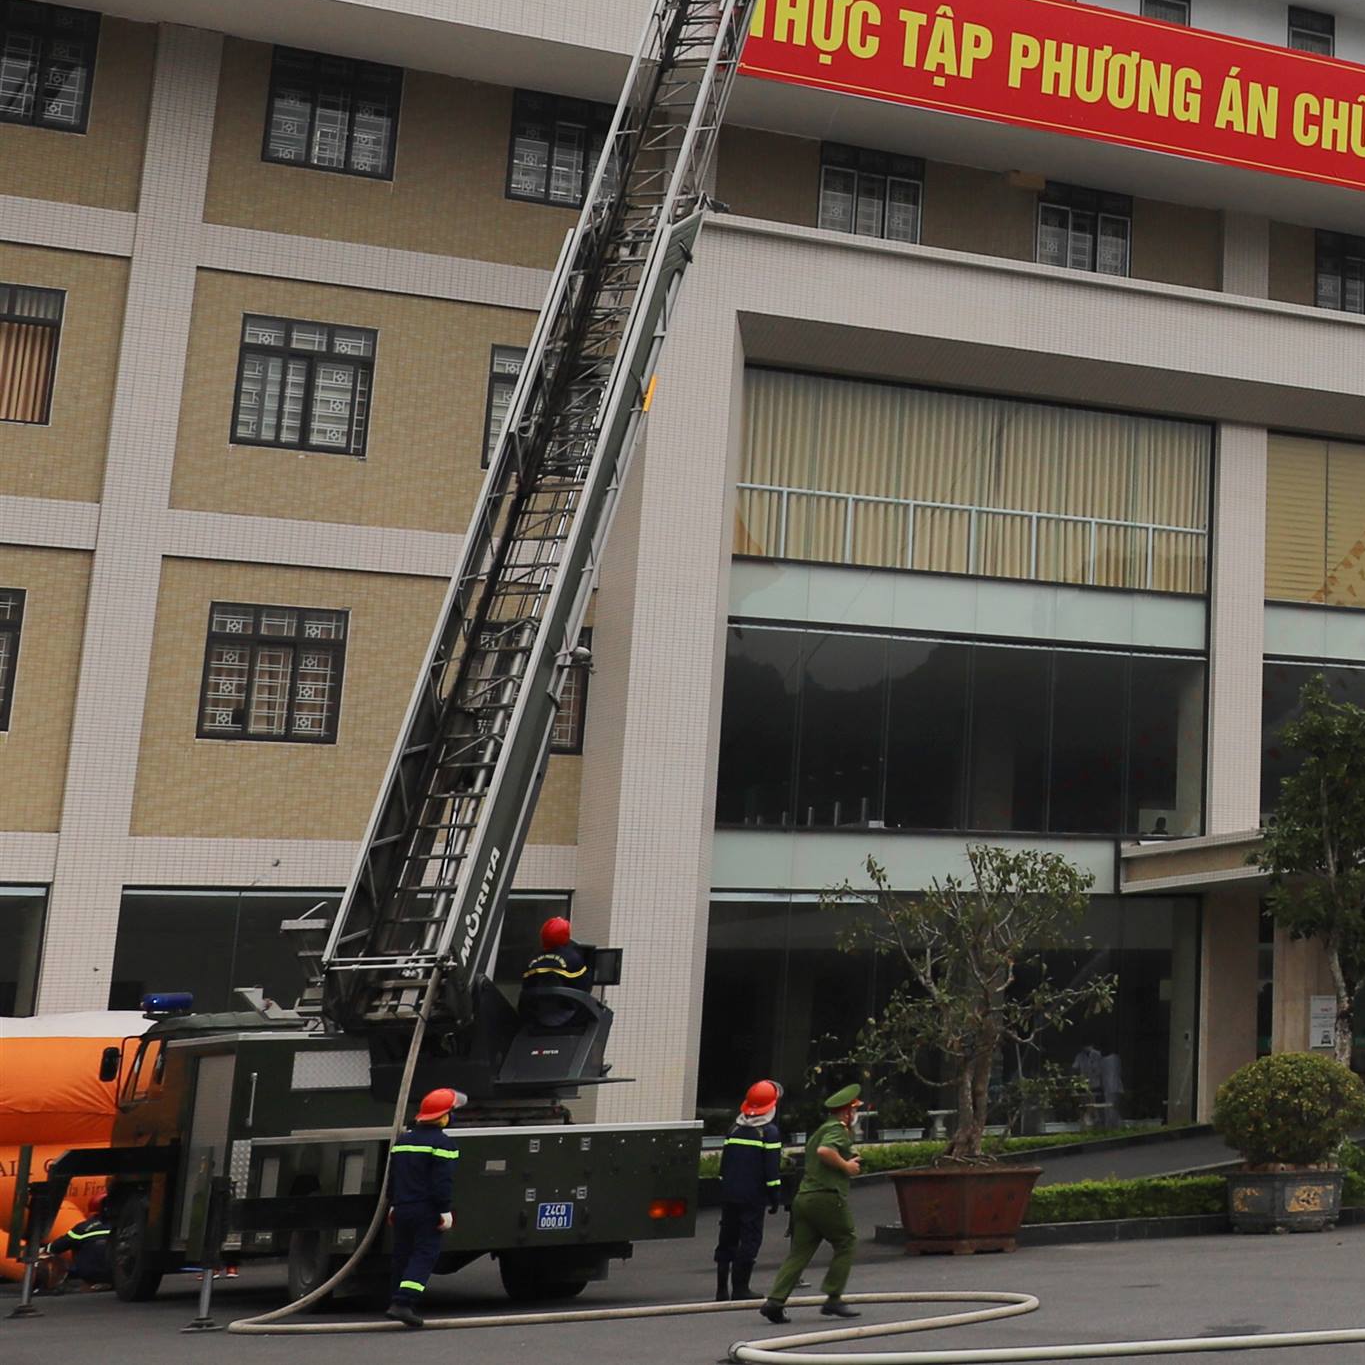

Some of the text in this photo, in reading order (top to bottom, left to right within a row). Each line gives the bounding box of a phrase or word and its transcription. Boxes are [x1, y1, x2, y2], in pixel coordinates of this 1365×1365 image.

[899, 5, 992, 86] TẬP
[1008, 32, 1202, 124] PHƯƠNG
[1216, 67, 1278, 139] ÁN
[460, 846, 501, 968] MORITA
